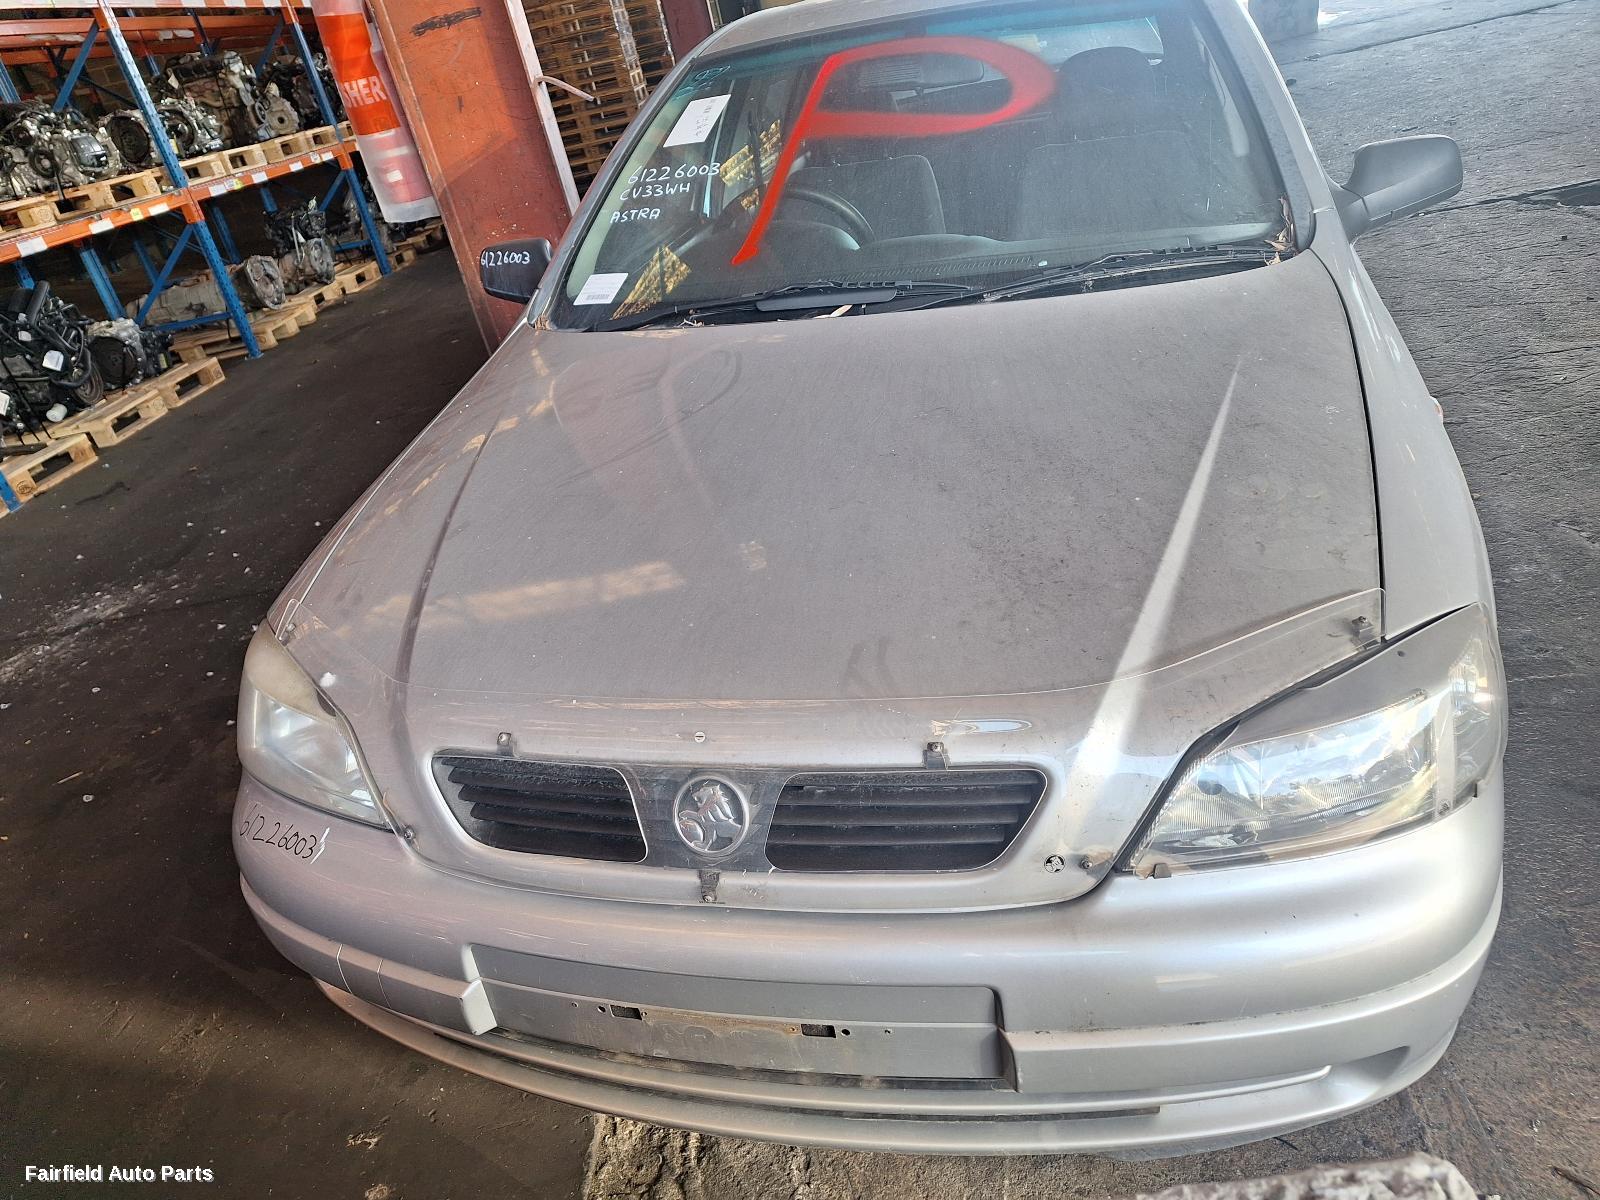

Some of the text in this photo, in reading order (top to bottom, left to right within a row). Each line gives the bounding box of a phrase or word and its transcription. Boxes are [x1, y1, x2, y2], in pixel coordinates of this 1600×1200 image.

[628, 162, 720, 184] 61226003
[620, 182, 691, 201] CV33WH
[610, 207, 661, 224] ASTRA
[480, 250, 530, 268] 61226003
